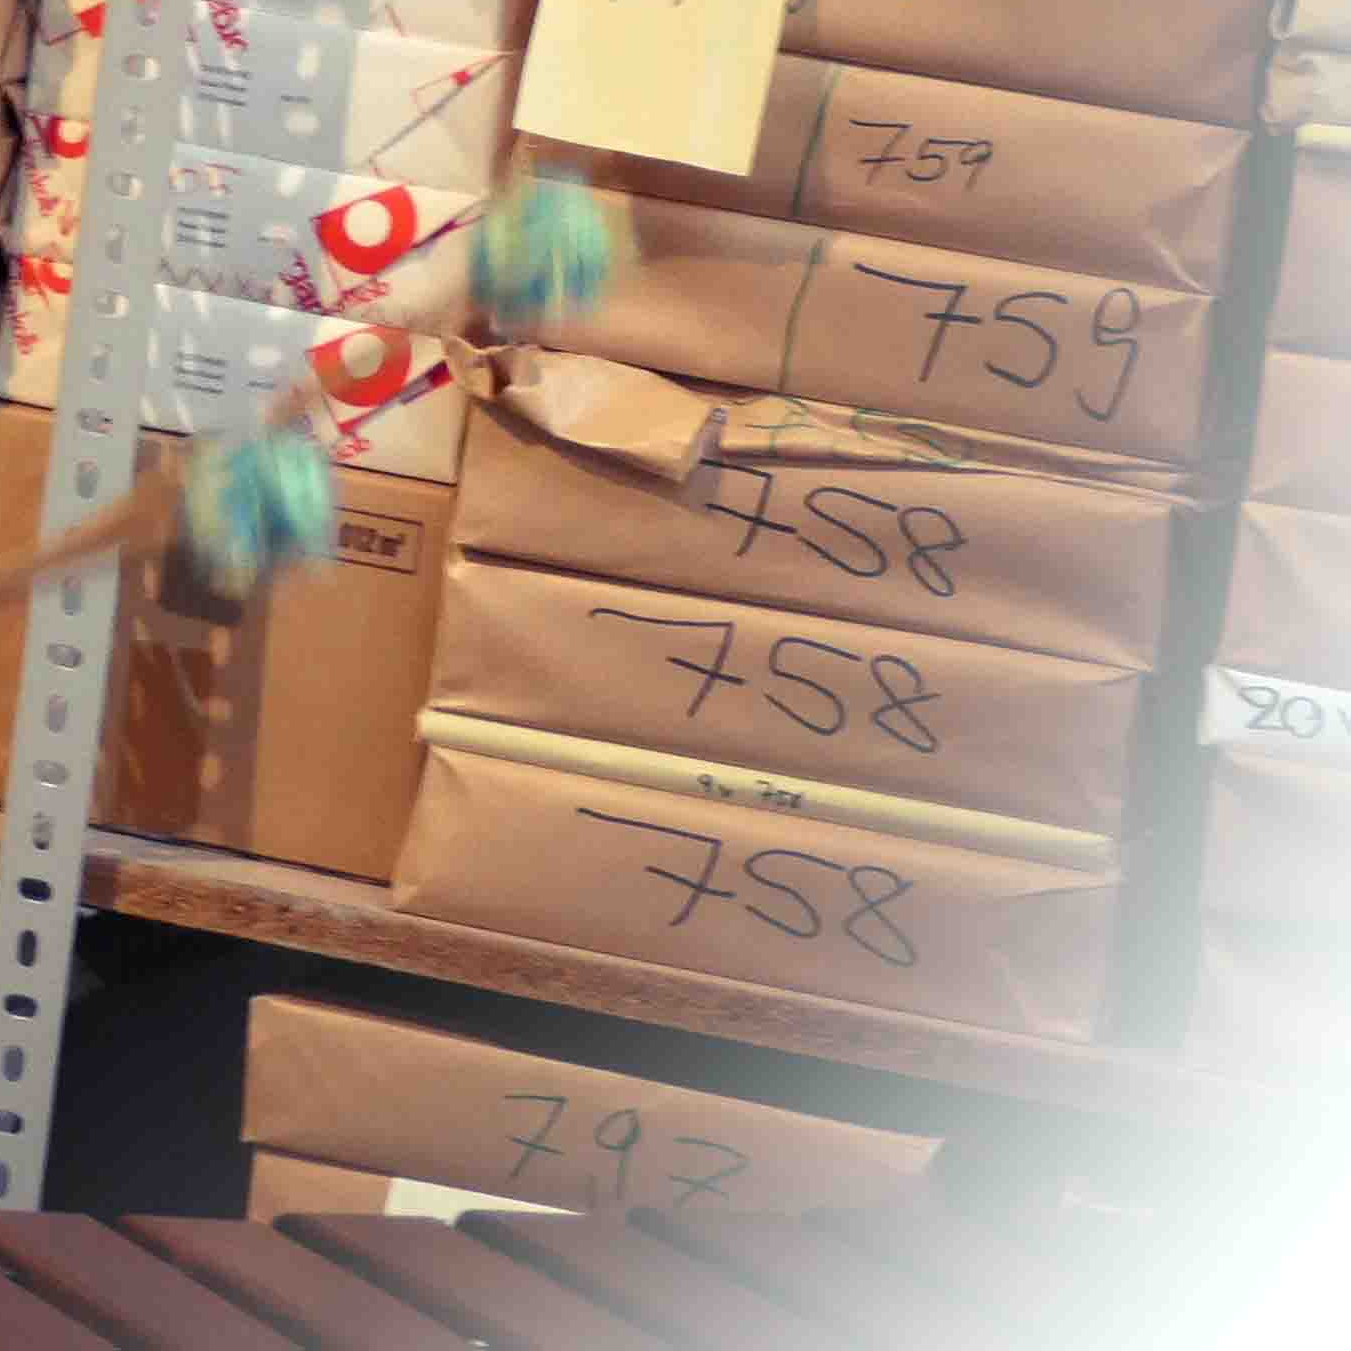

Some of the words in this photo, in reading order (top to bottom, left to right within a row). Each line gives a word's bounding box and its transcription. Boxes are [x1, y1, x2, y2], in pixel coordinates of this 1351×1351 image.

[848, 118, 994, 191] 759
[854, 262, 1141, 422] 759
[698, 458, 969, 598] 758
[589, 608, 942, 754] 758
[575, 807, 917, 968] 758
